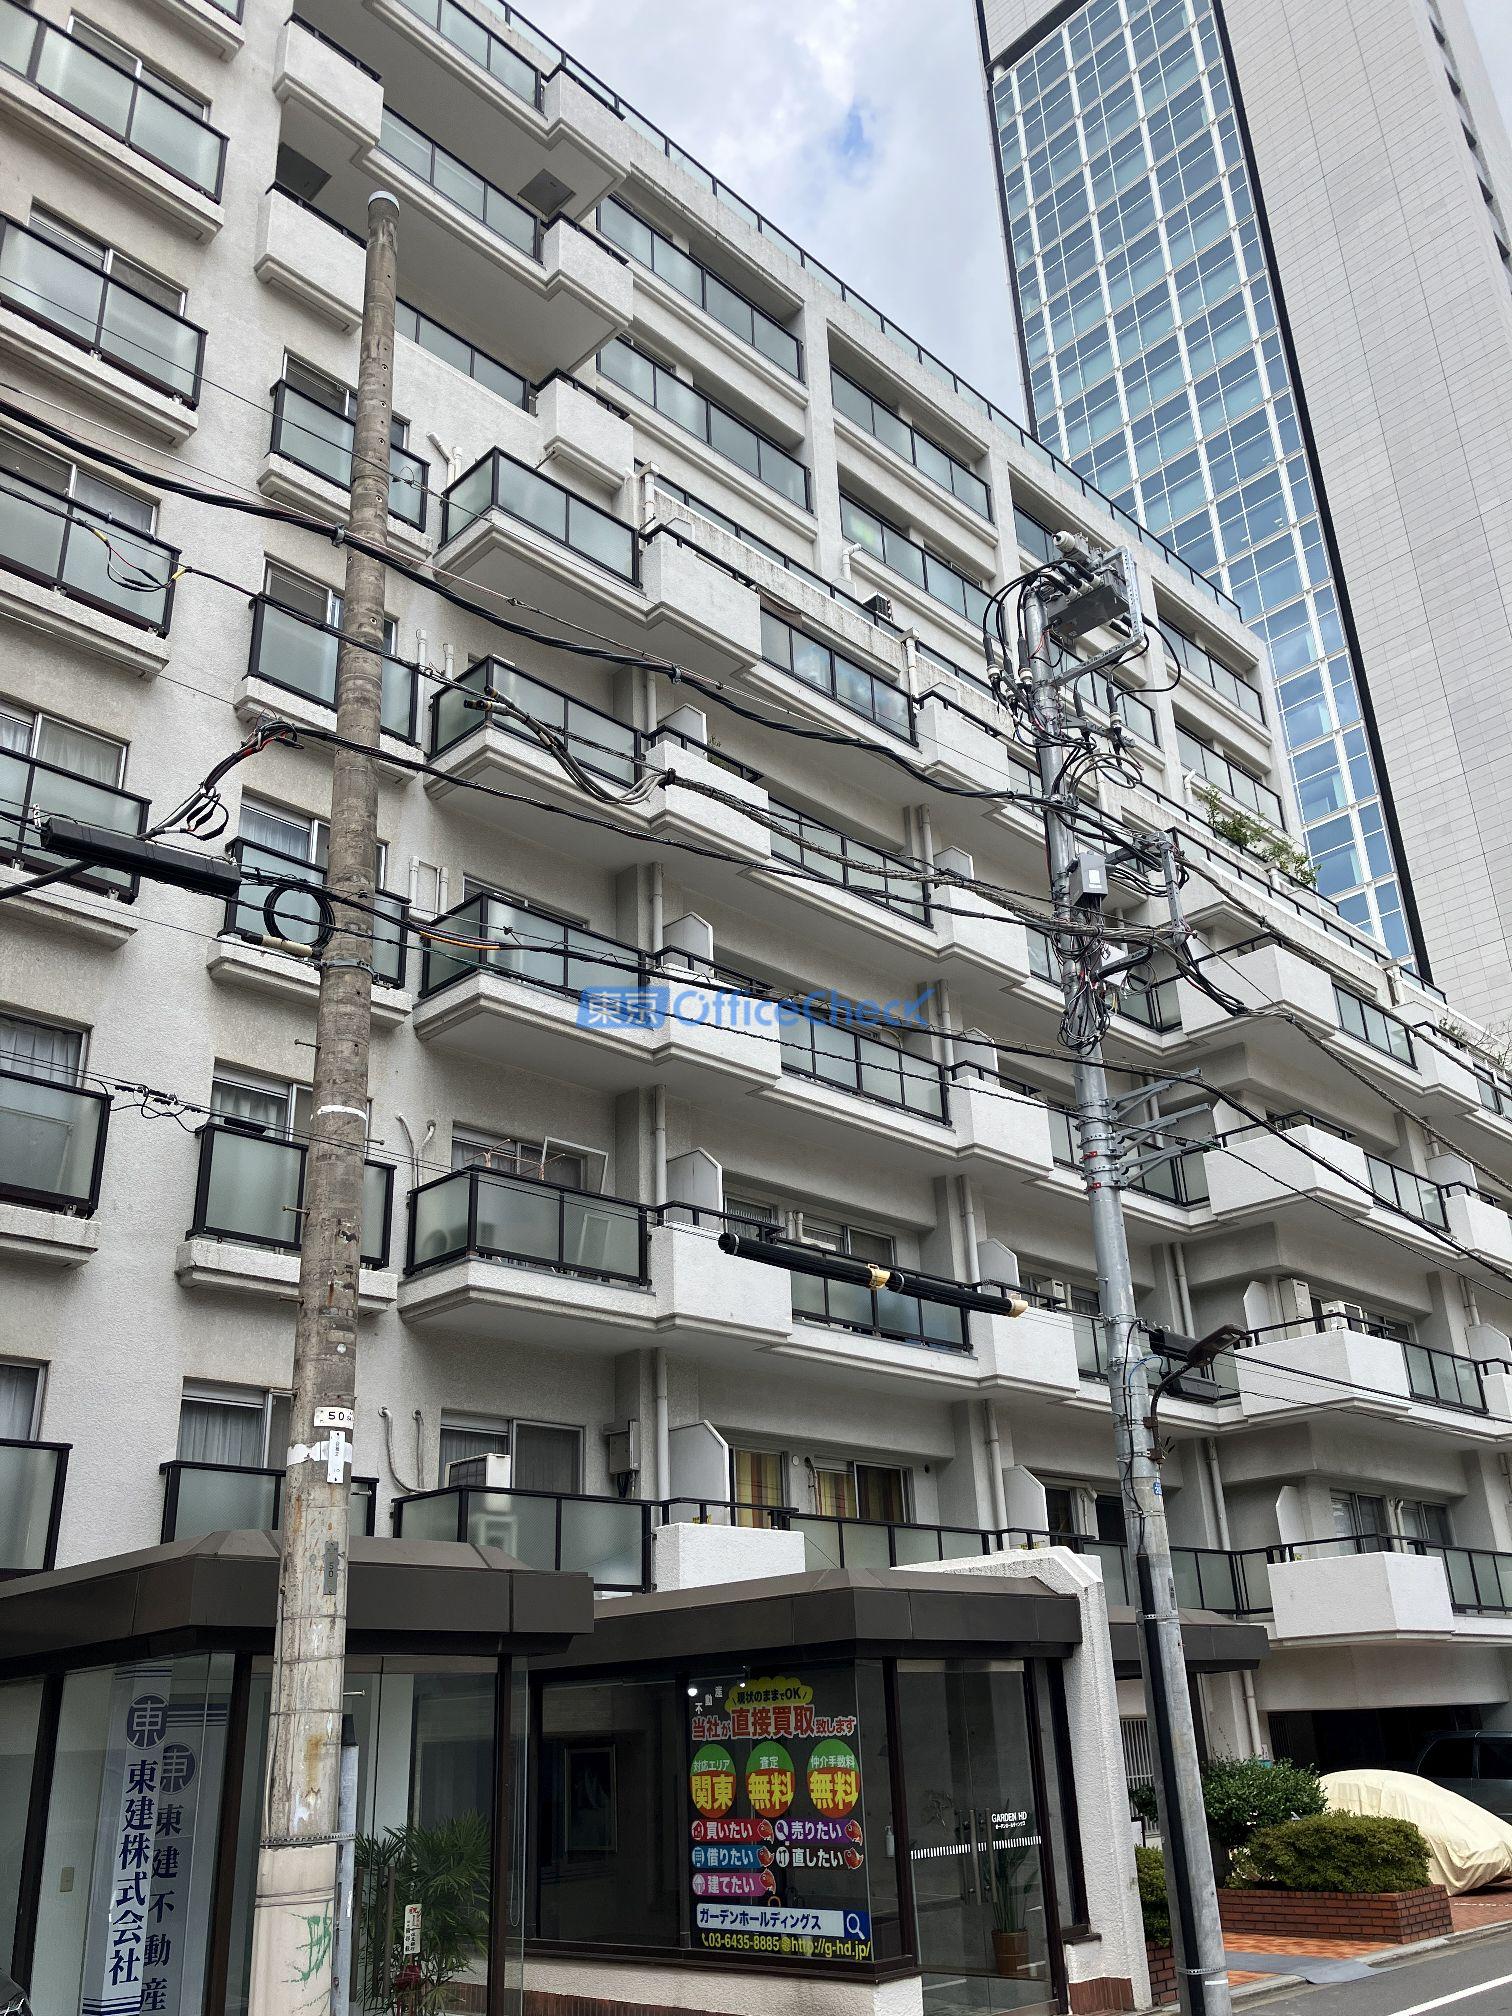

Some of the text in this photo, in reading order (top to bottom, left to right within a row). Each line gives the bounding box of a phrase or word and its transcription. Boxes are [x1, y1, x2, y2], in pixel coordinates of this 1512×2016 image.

[328, 1411, 345, 1421] 50
[695, 1685, 723, 1715] 不動産
[737, 1687, 801, 1702] 現状のままでOK
[130, 1699, 167, 1748] 東
[692, 1704, 857, 1741] 当社が直接買取致します
[693, 1759, 731, 1772] 対応エリア
[759, 1756, 779, 1769] 査定
[810, 1755, 856, 1769] 仲介手数料
[692, 1774, 734, 1810] 関東
[748, 1771, 794, 1810] 無料
[809, 1770, 859, 1810] 無料
[991, 1811, 1027, 1822] GARDEN HD
[706, 1821, 753, 1839] 買いたい
[791, 1821, 842, 1840] 売りたい
[707, 1847, 754, 1867] 借りたい
[792, 1848, 844, 1867] 直したい
[108, 1759, 158, 1986] 東建株式会社
[707, 1875, 755, 1894] 建てたい
[140, 1804, 184, 2013] 東建不動産
[700, 1907, 822, 1931] ガーデンホールディングス
[709, 1932, 872, 1961] 03-6435-8885 http://g-hd.jp/
